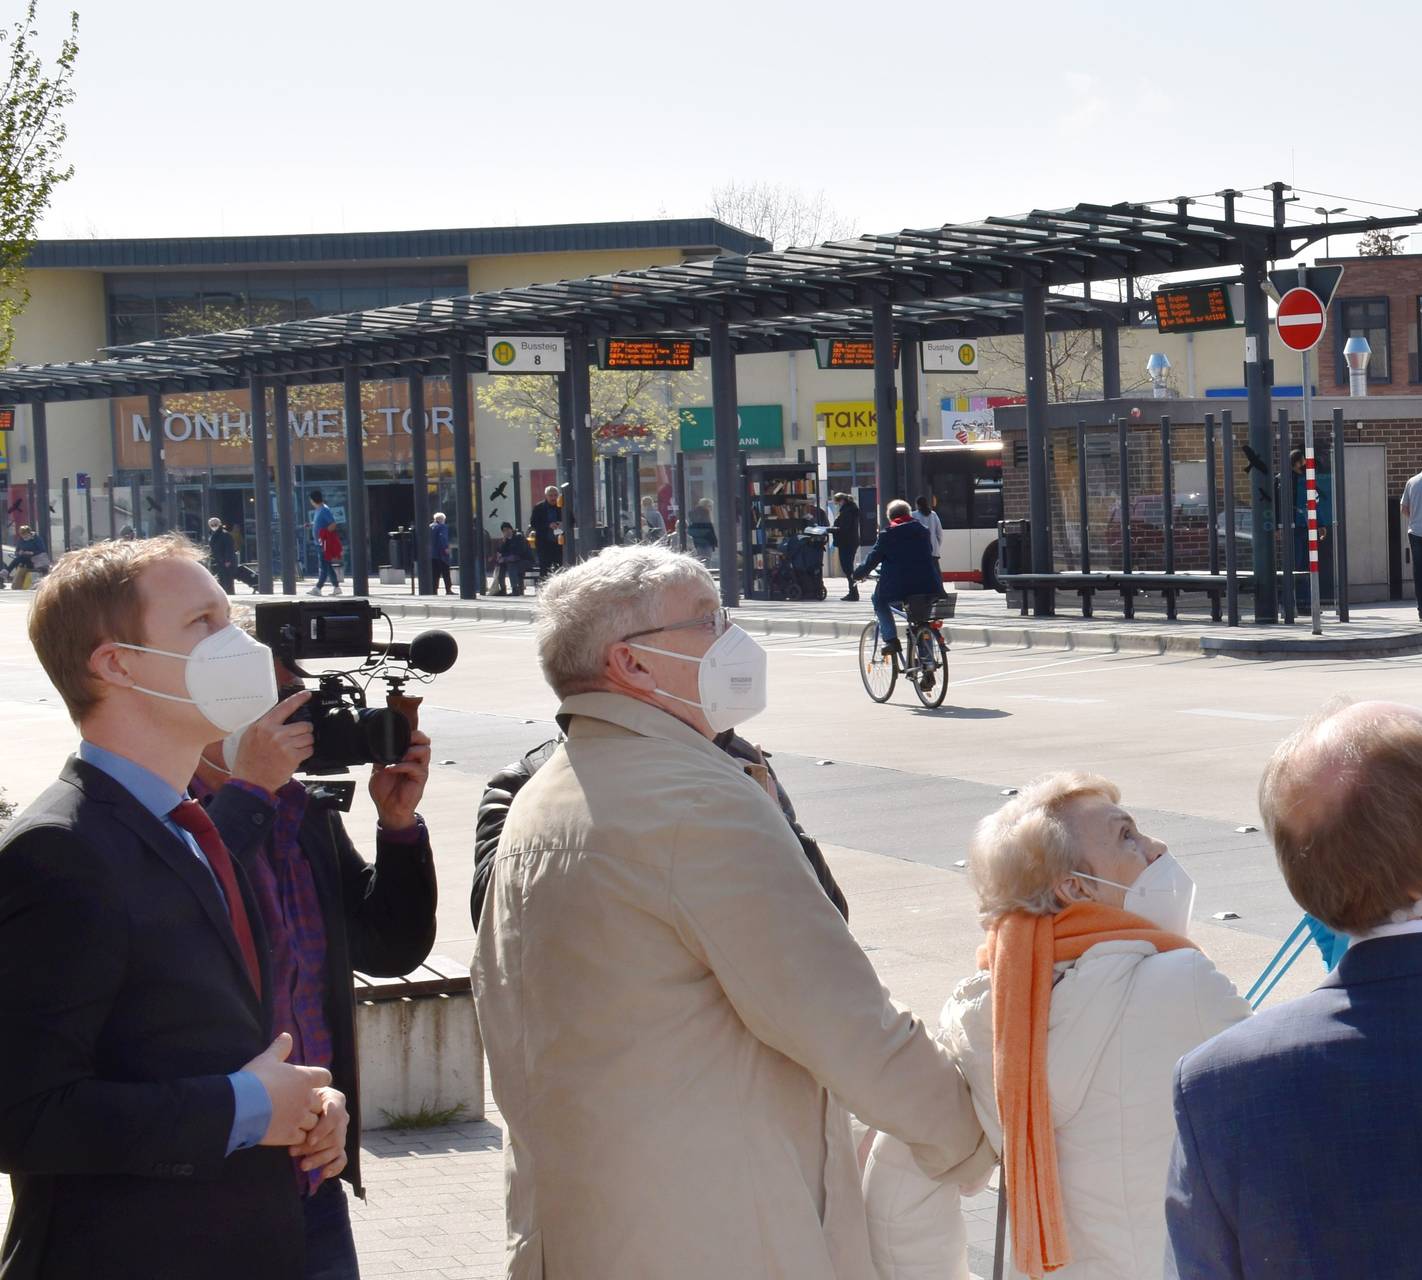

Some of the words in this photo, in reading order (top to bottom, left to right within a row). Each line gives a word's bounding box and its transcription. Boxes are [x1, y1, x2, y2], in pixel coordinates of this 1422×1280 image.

[521, 341, 558, 352] Bussteig
[927, 342, 955, 353] Bussteig
[534, 354, 541, 365] 8
[131, 407, 368, 443] MONHME
[377, 406, 455, 436] TOR
[833, 430, 877, 440] FASHIO
[703, 437, 760, 447] DEANN
